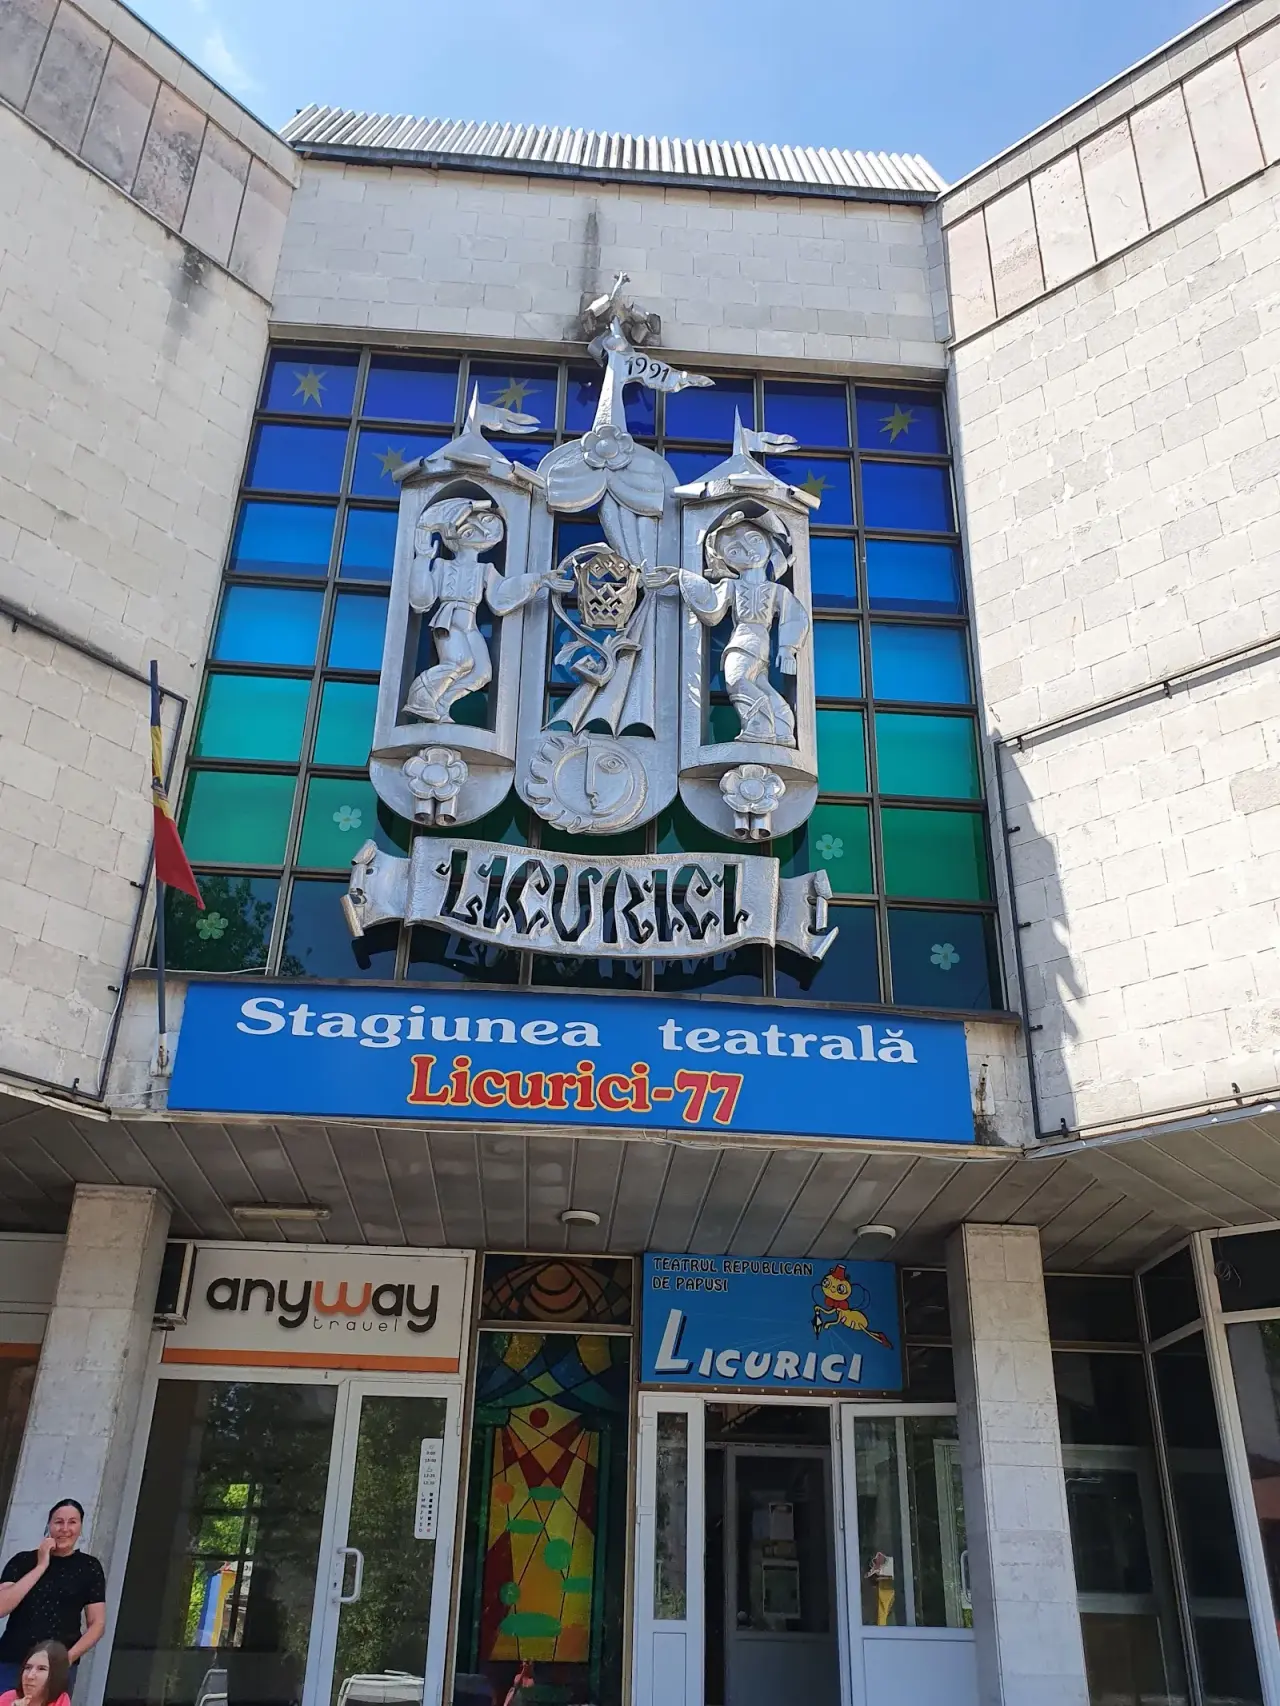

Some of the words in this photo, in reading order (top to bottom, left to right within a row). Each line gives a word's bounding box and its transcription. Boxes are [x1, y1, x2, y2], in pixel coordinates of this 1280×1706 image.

[625, 357, 670, 382] 1991
[436, 848, 749, 944] LICURICI
[236, 997, 601, 1048] Stagiunea
[658, 1018, 918, 1064] teatrală
[406, 1054, 744, 1125] Licurici-77
[652, 1276, 670, 1290] DE
[675, 1277, 728, 1292] PAPUSI
[653, 1257, 718, 1273] TEATRUL
[723, 1259, 814, 1277] REPUBLICAN
[206, 1277, 439, 1332] anyway
[313, 1317, 399, 1332] travel
[654, 1308, 863, 1383] LICURICI
